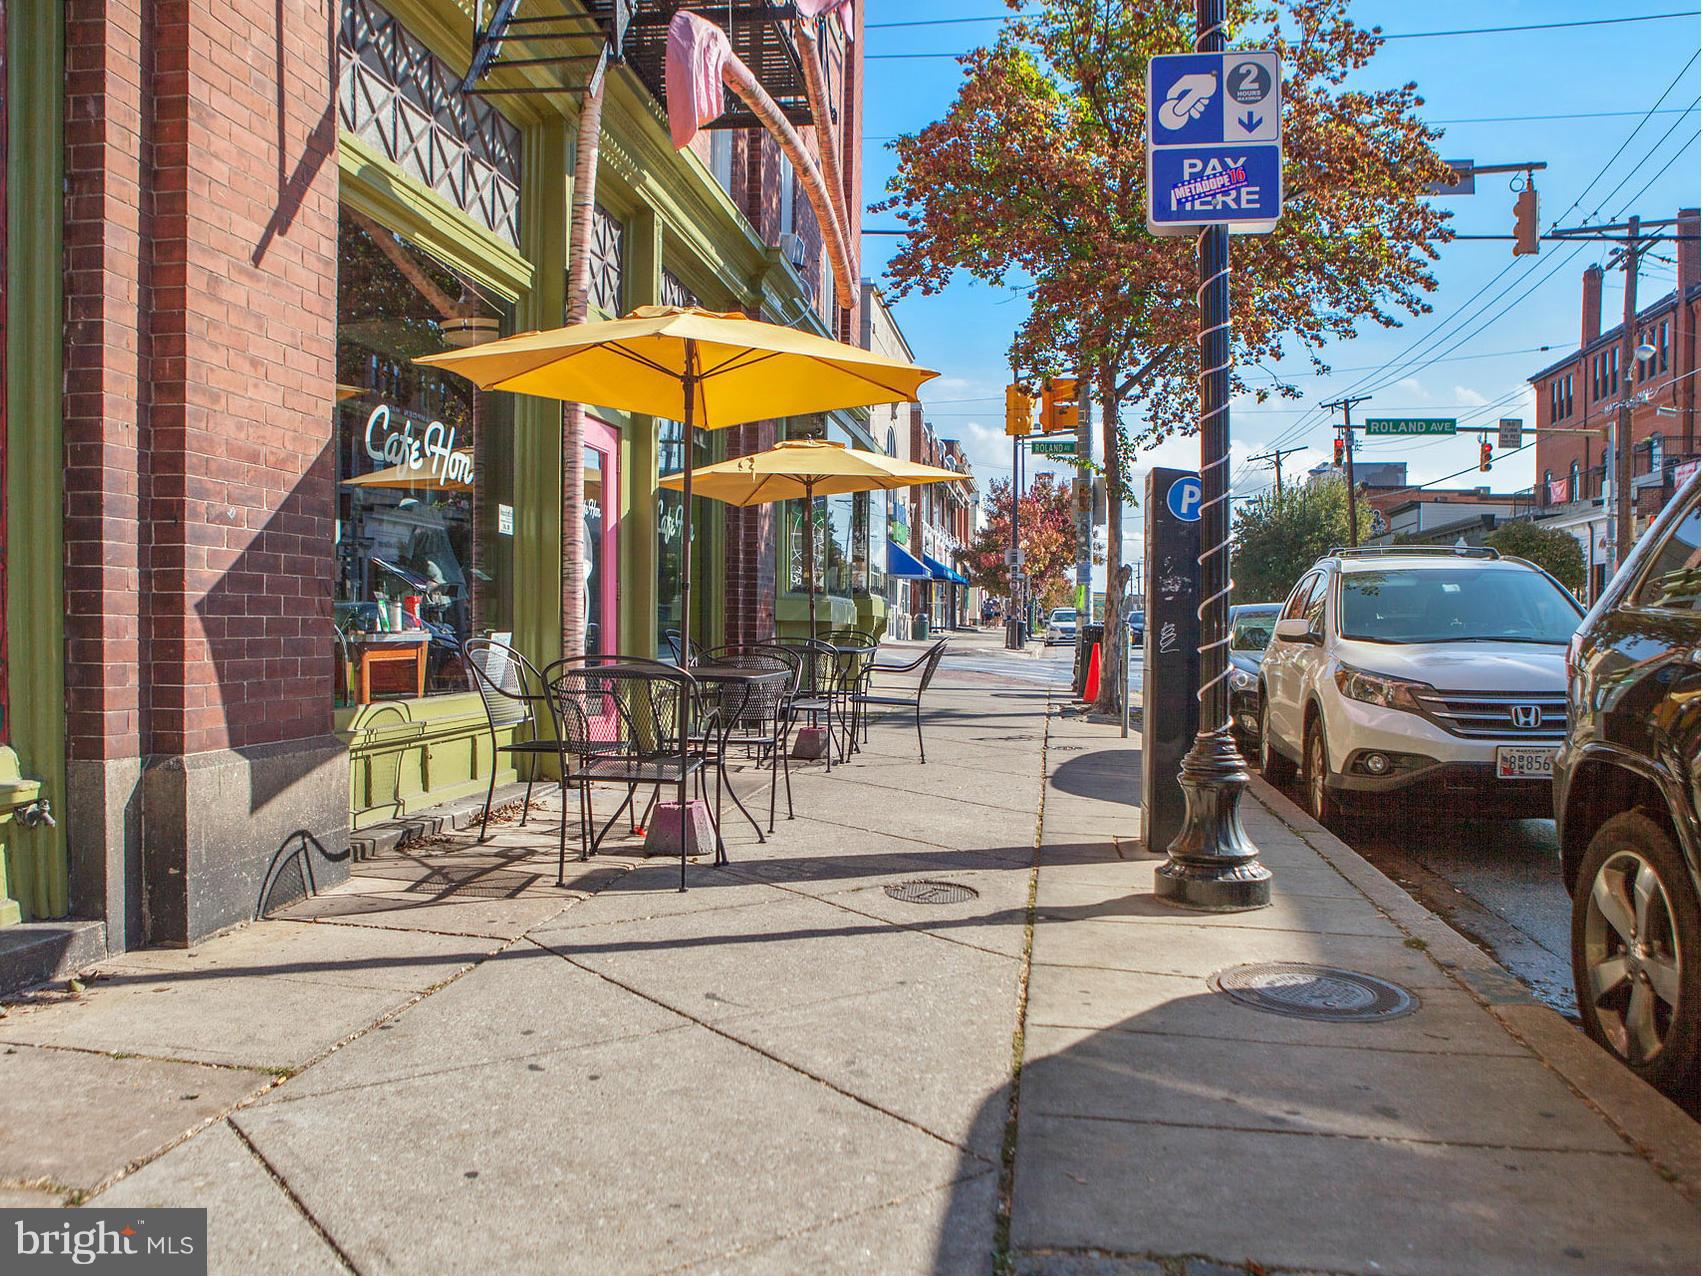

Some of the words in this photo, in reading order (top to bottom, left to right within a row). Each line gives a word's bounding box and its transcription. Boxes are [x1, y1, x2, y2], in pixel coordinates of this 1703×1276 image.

[1239, 64, 1259, 90] 2
[1183, 157, 1247, 181] PAY
[1370, 421, 1426, 433] ROLAND
[365, 404, 423, 479] Cafe
[424, 421, 474, 487] Hon
[1035, 443, 1063, 453] ROLAND
[1181, 484, 1201, 514] P
